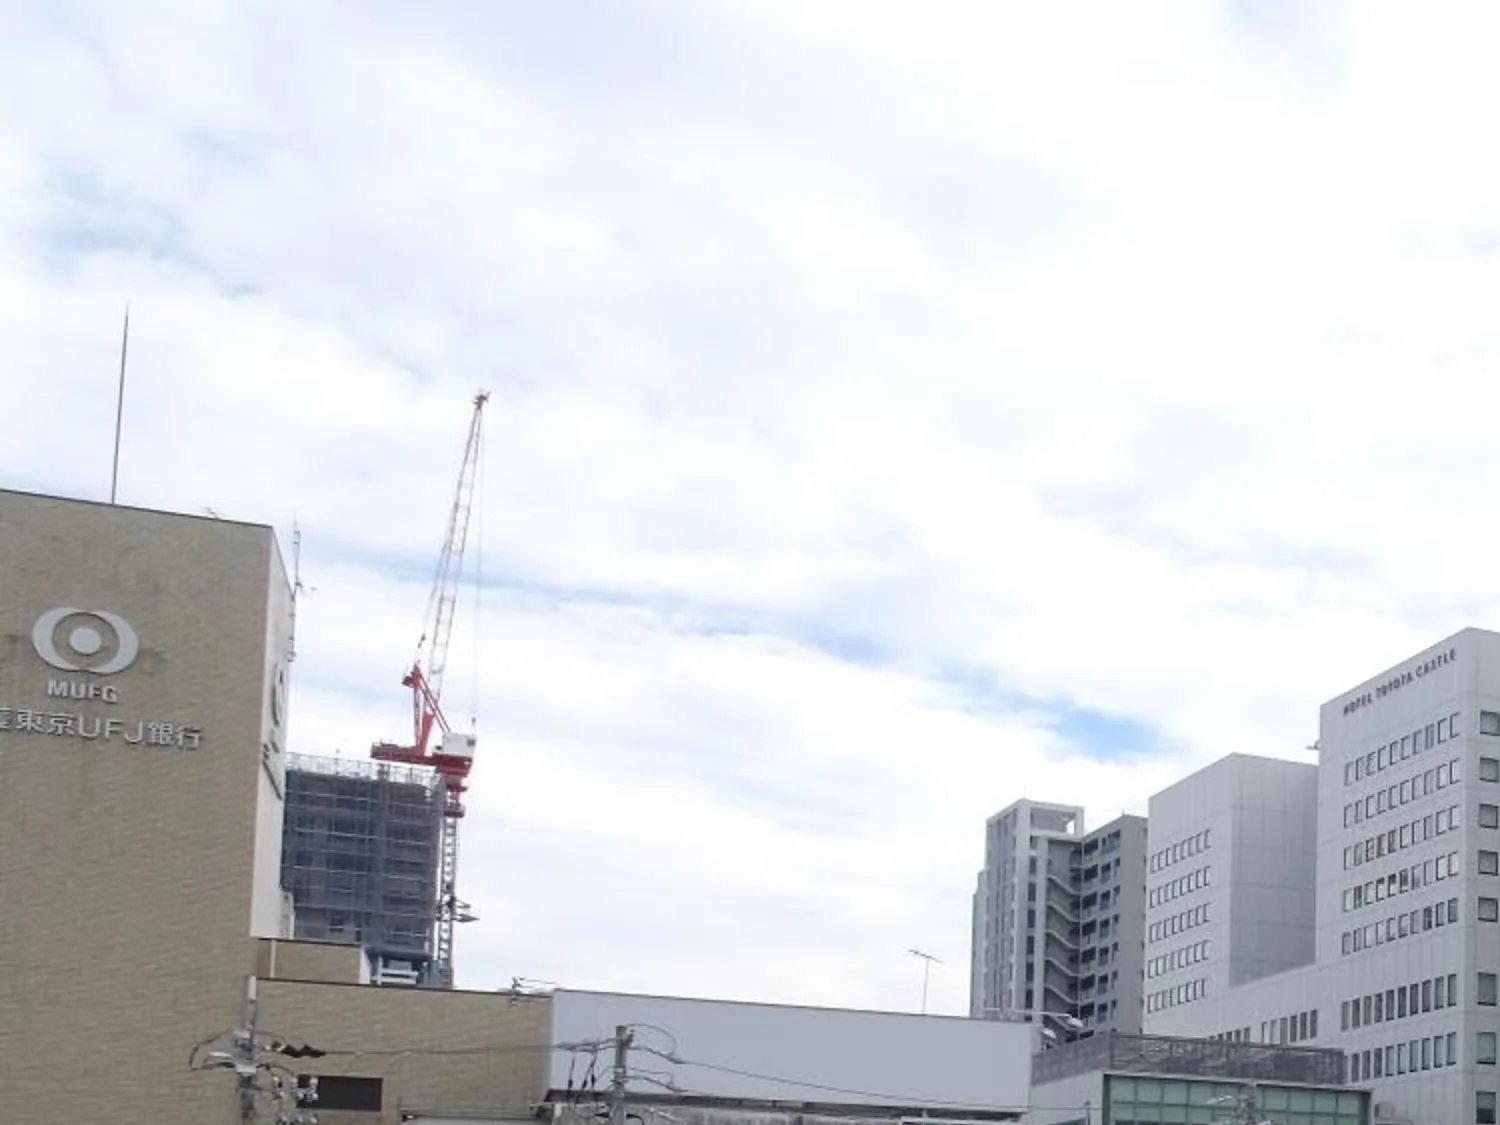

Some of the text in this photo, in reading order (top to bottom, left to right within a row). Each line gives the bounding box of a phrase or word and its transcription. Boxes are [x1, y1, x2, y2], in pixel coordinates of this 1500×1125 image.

[47, 679, 118, 704] MUFG
[1375, 672, 1413, 700] TOYOTA
[1415, 648, 1456, 678] CASTLE
